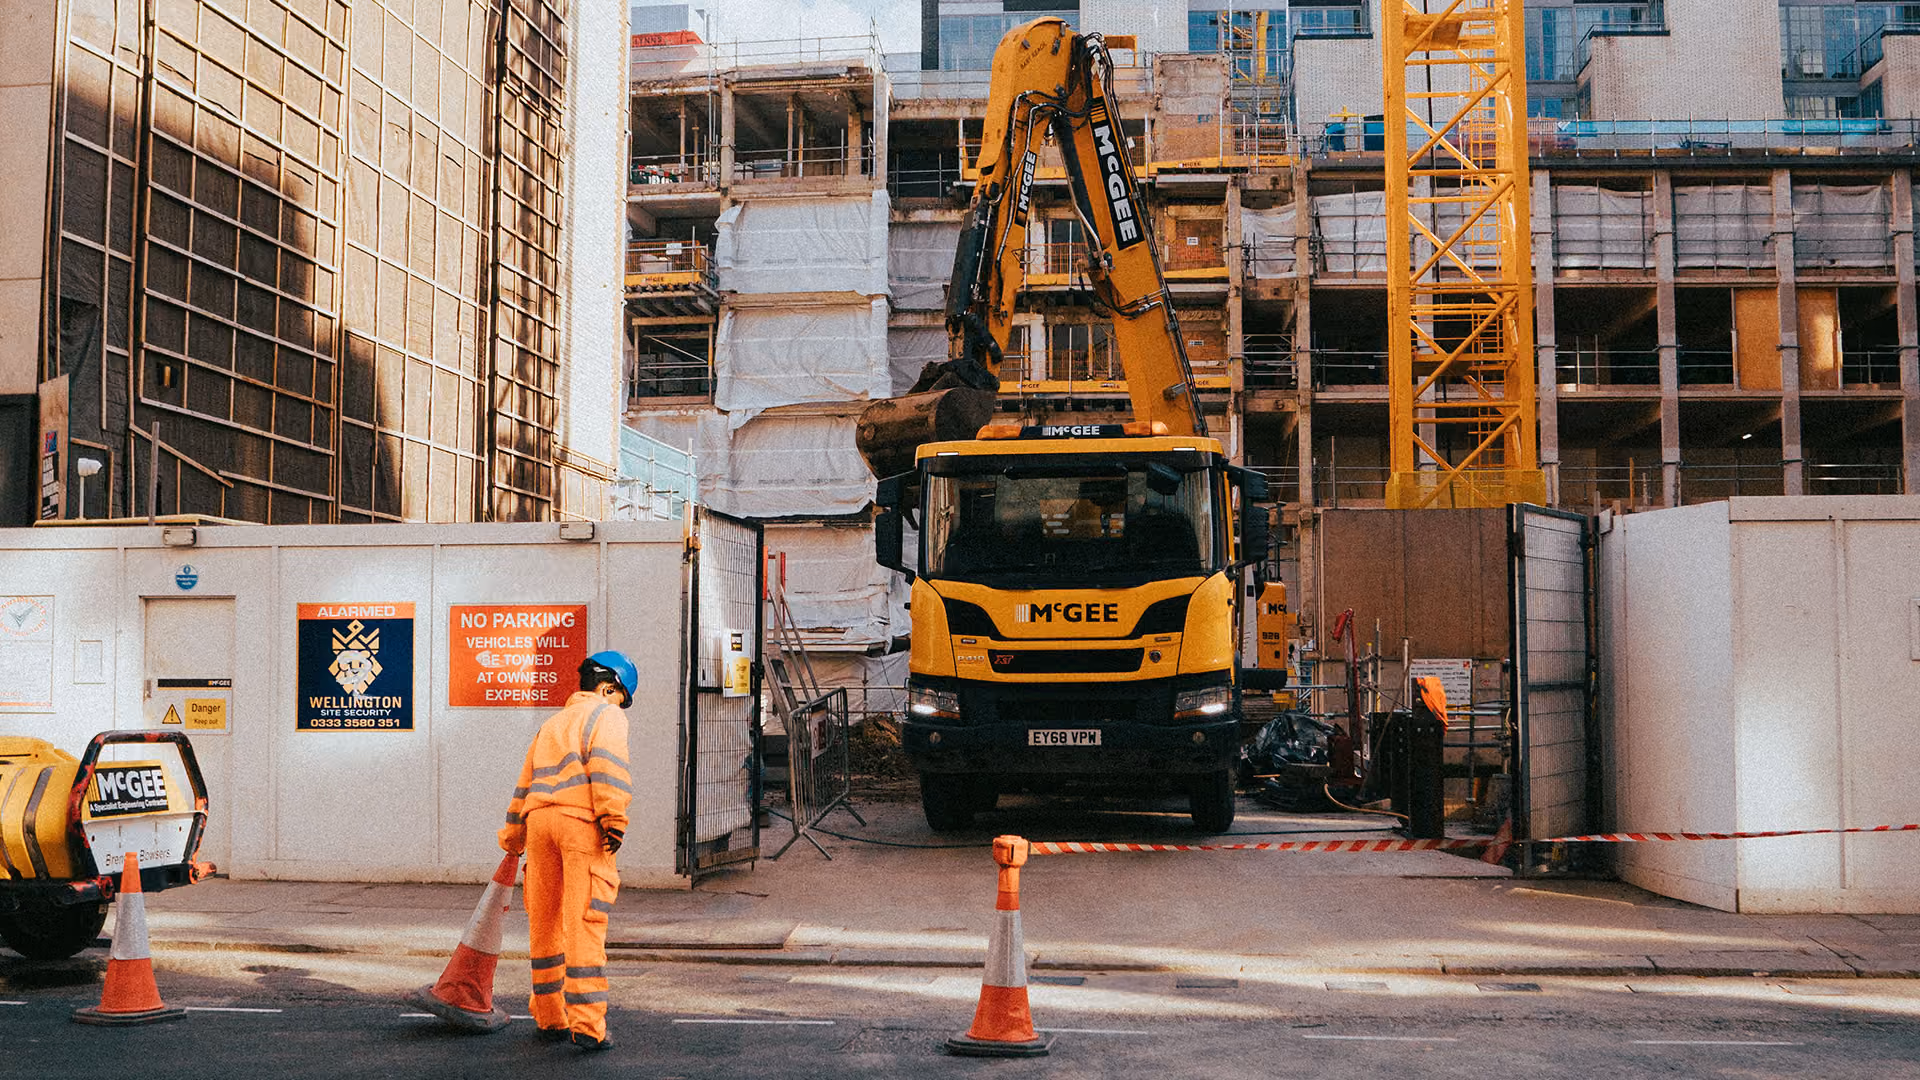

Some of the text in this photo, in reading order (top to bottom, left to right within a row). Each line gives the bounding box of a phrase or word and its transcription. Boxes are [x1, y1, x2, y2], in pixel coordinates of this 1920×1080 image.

[1018, 151, 1036, 211] McGEE
[1094, 125, 1137, 242] McGEE
[1051, 426, 1100, 436] McGEE
[317, 605, 396, 617] ALARMED
[1030, 603, 1118, 623] McGEE
[460, 612, 576, 629] NO PARKING
[466, 636, 570, 649] VEHICLES WILL
[482, 654, 554, 666] BE TOWED
[476, 672, 558, 684] AT OWNERS
[485, 689, 549, 701] EXPENSE
[191, 703, 221, 715] Danger
[309, 696, 402, 709] WELLINGTON
[320, 709, 392, 717] SITE SECURITY
[310, 719, 401, 728] 0333 3580 351
[1033, 731, 1096, 744] EY68 VPW
[96, 769, 167, 800] McGEE
[105, 853, 125, 867] Bren
